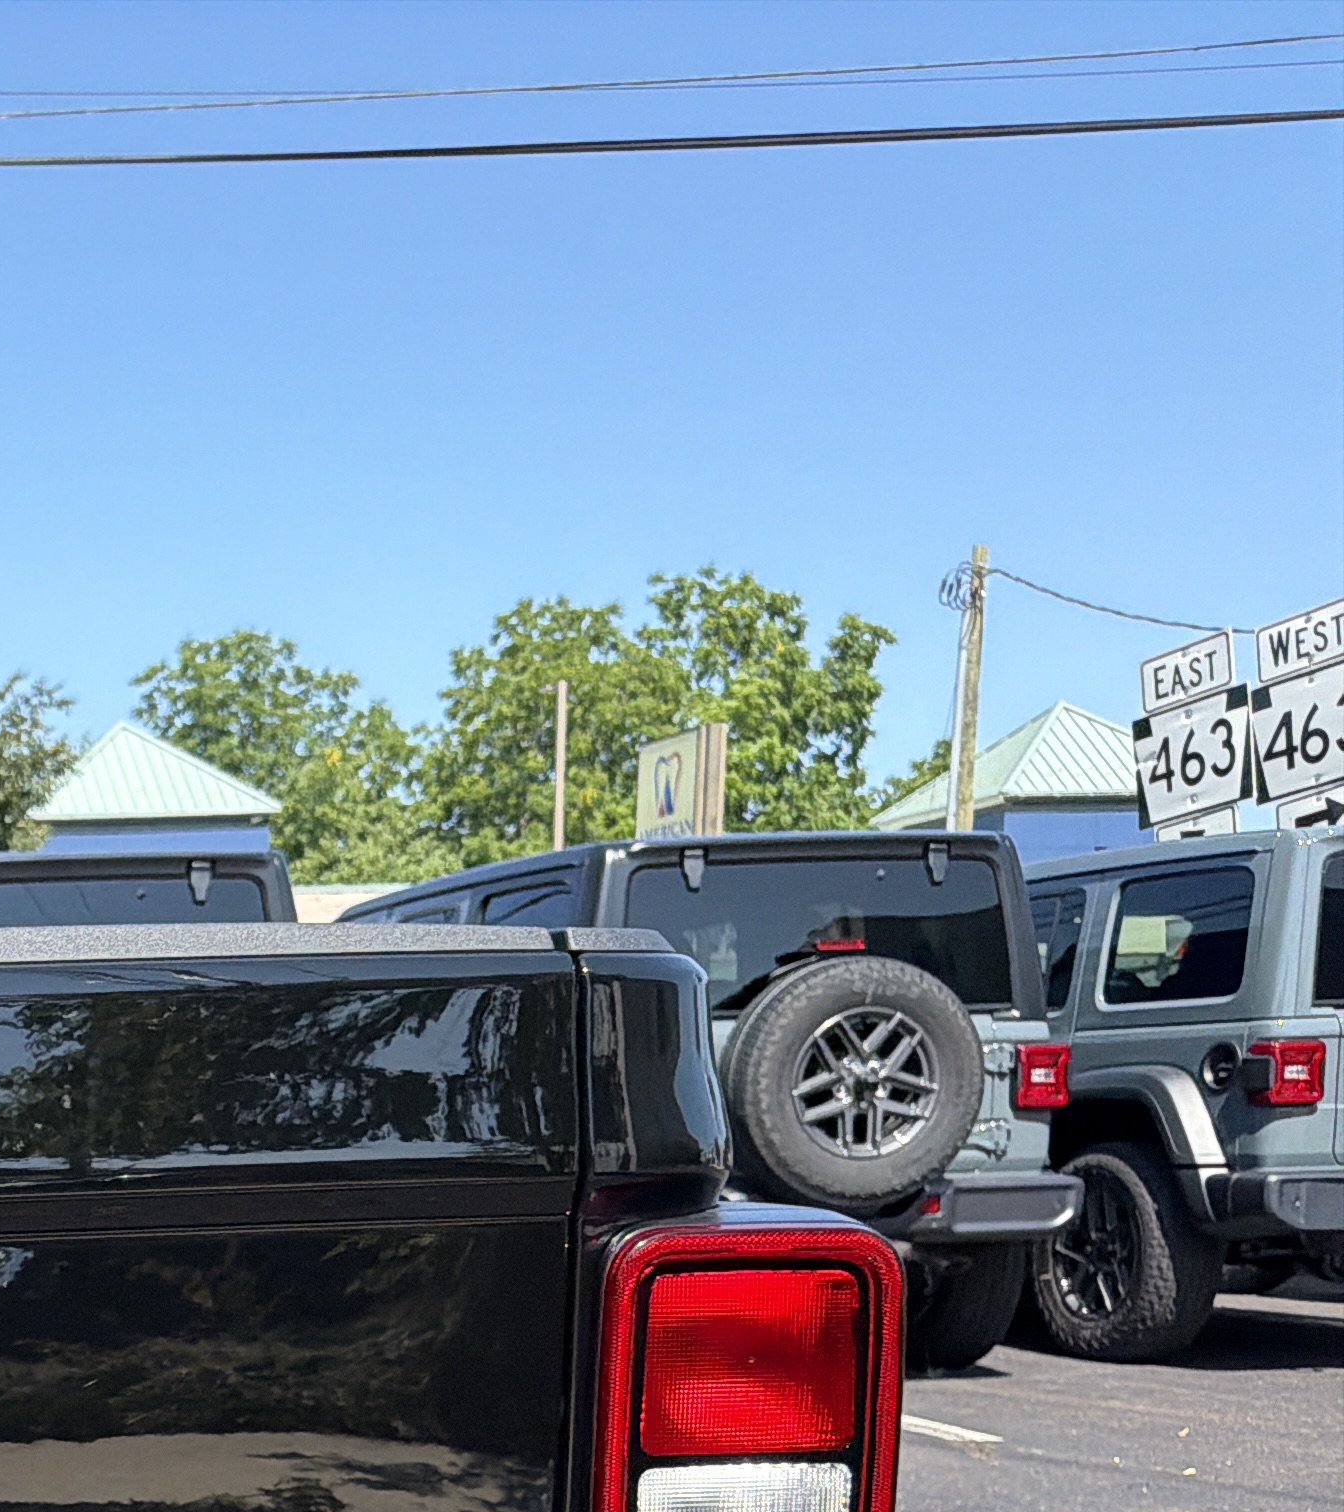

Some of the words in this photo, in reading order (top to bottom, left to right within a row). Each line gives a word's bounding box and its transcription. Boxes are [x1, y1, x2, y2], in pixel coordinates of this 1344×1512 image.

[1153, 651, 1218, 701] EAST
[1149, 718, 1236, 794] 463
[1263, 694, 1344, 771] 46
